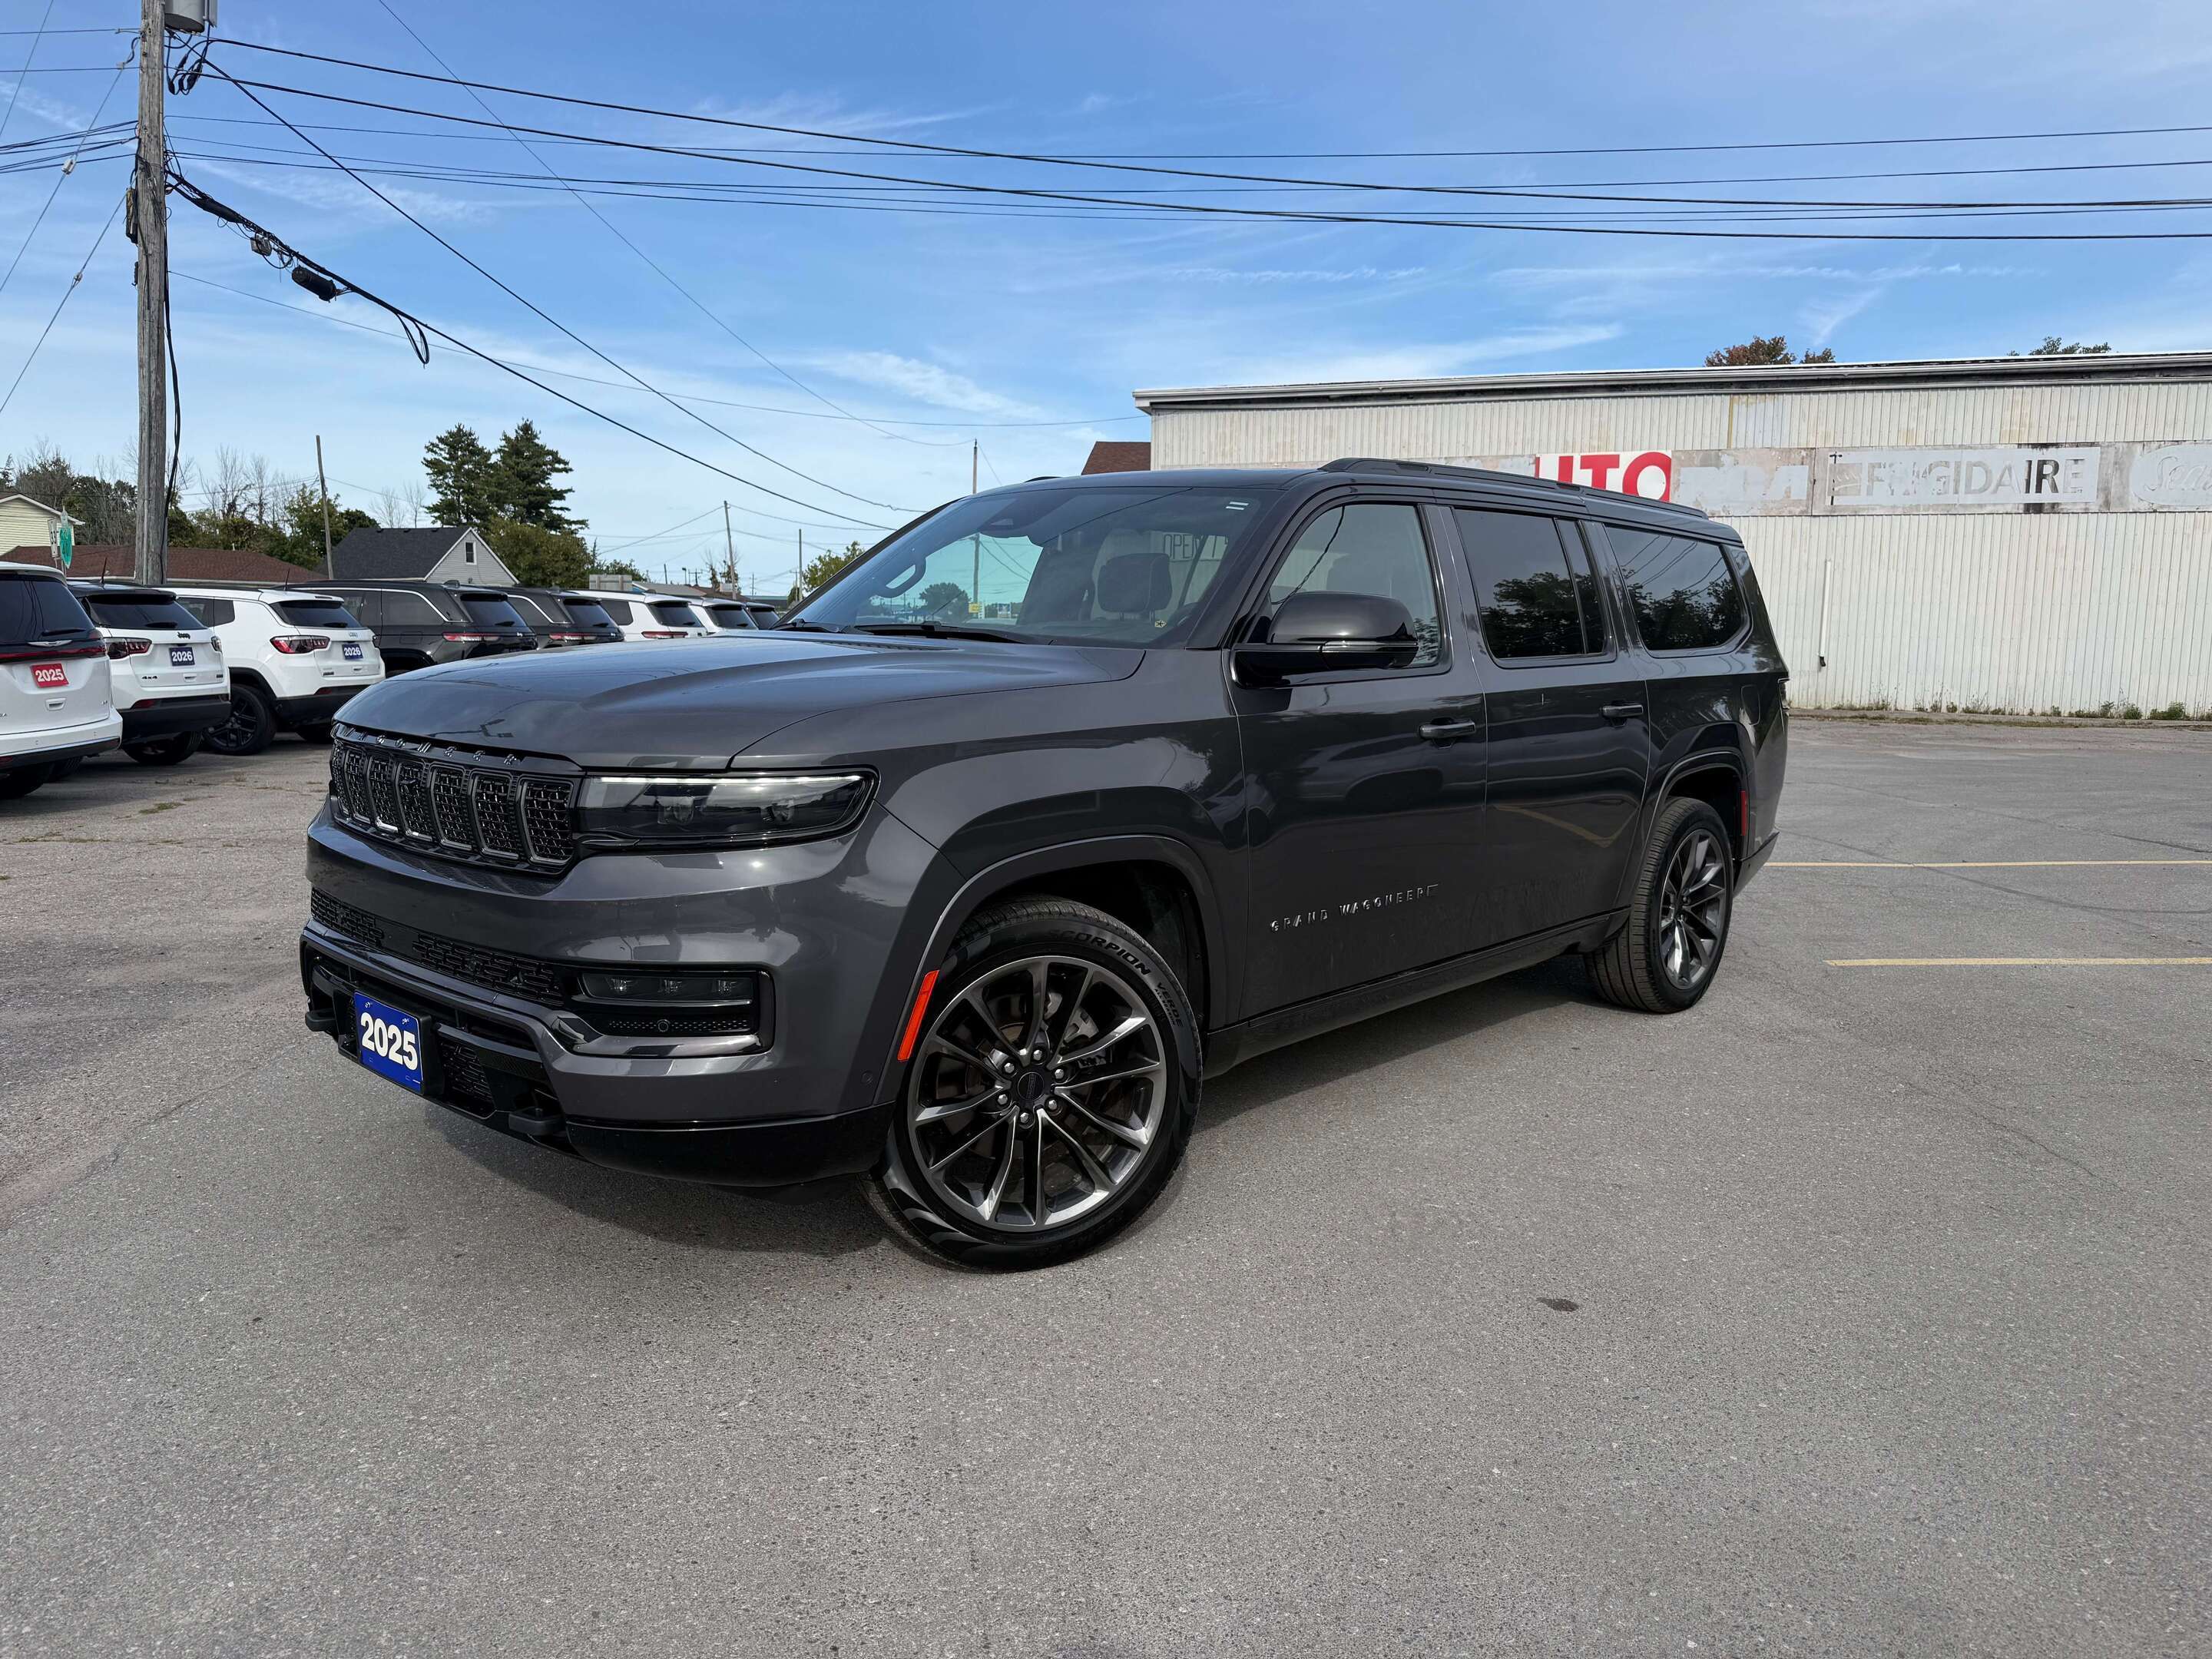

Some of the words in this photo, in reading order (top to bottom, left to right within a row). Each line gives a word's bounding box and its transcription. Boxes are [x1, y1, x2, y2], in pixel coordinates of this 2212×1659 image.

[1866, 459, 2085, 497] FIGIDAIRE
[171, 651, 194, 662] 2026
[343, 647, 362, 656] 2026
[35, 668, 65, 682] 2025
[1270, 909, 1329, 932] GRAND
[1339, 887, 1424, 916] WAGONEER
[1045, 929, 1151, 975] SCORPION
[360, 1012, 419, 1071] 2025
